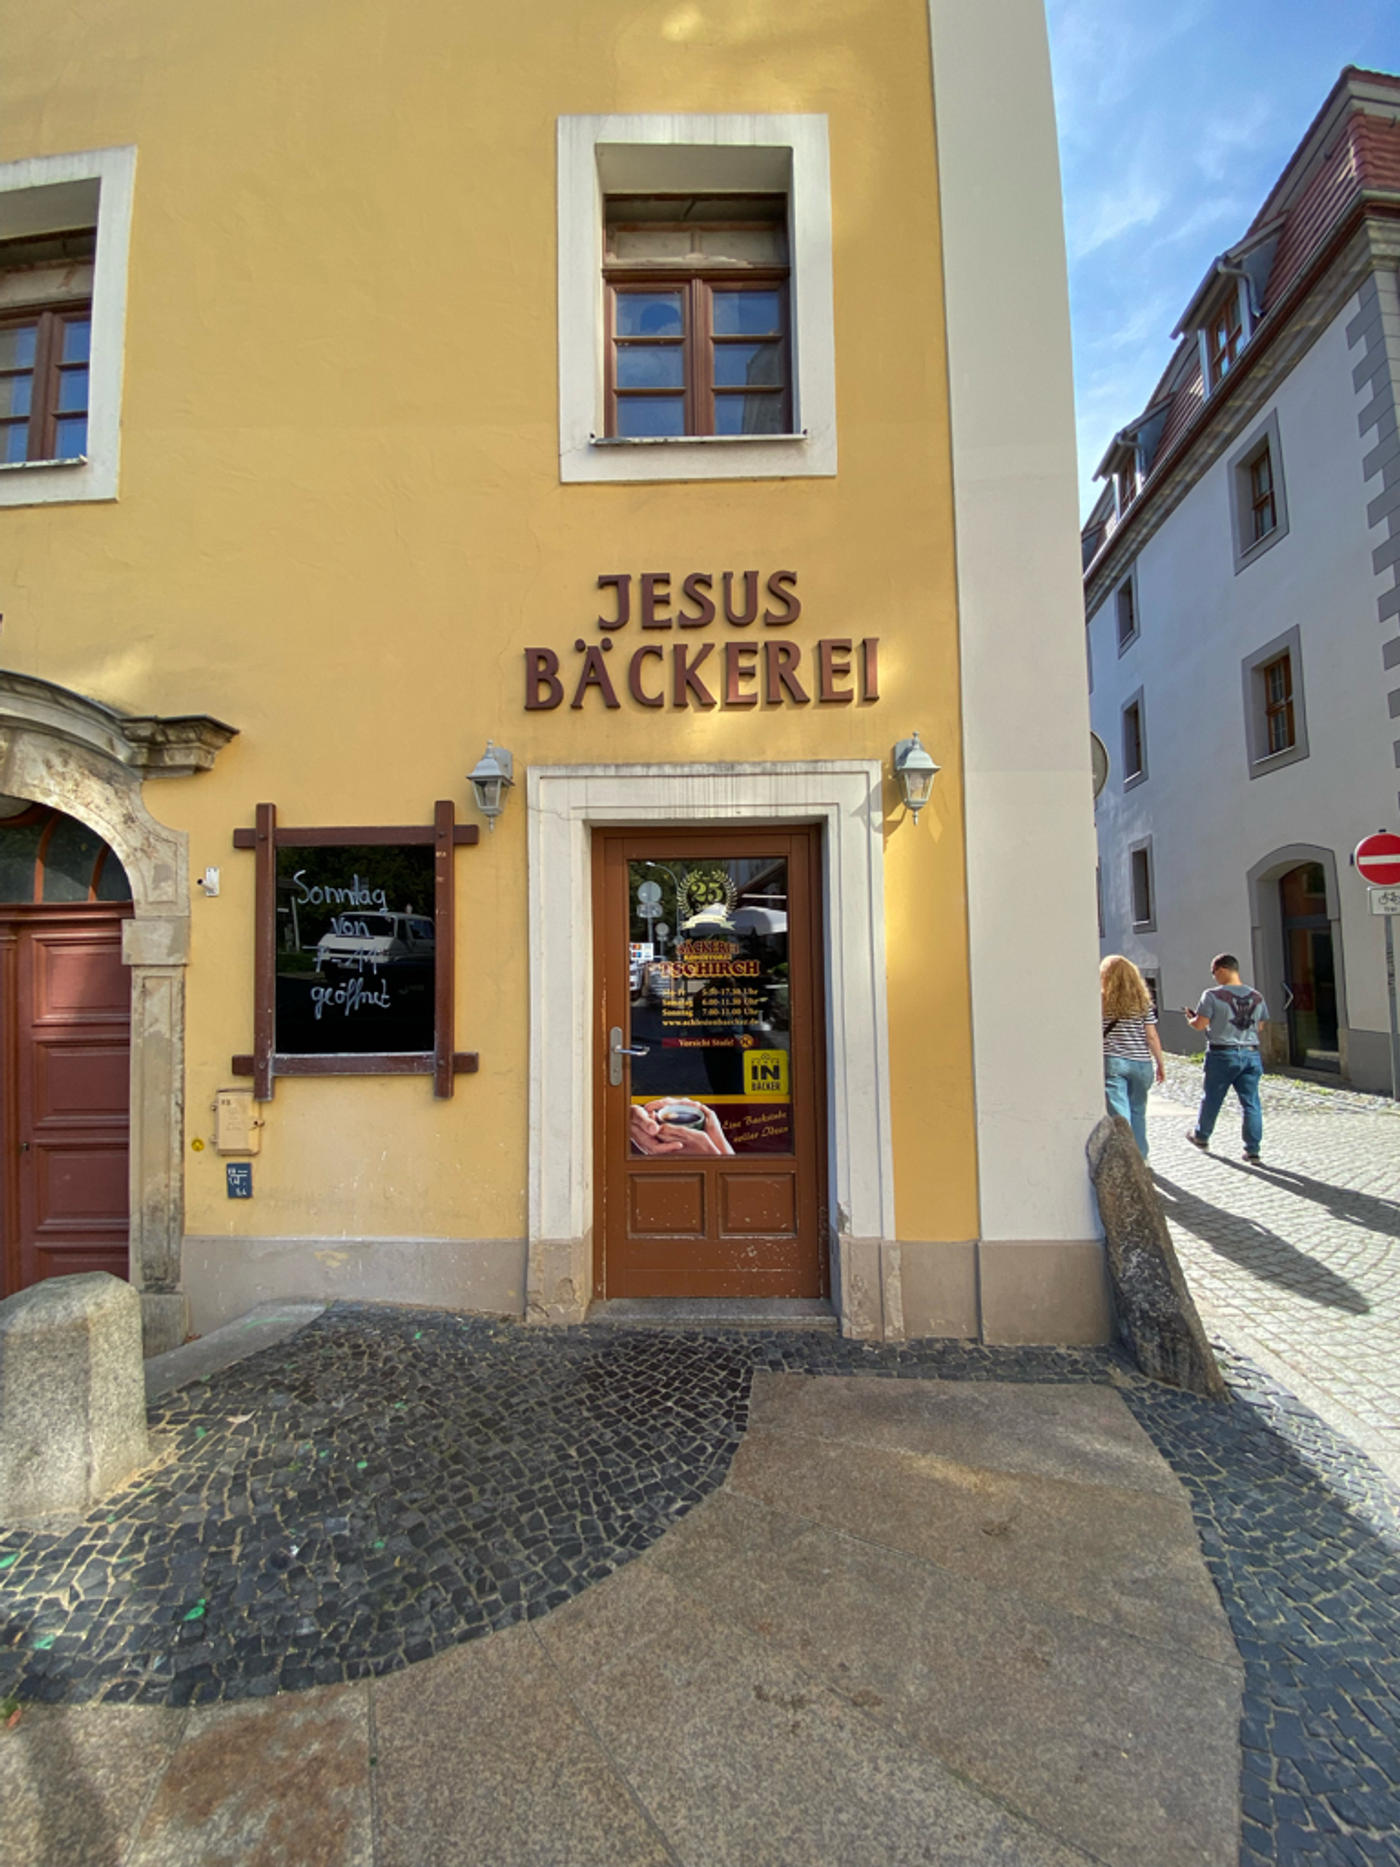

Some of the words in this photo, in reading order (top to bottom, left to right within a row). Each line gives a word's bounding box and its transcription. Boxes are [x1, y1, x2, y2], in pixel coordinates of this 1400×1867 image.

[597, 570, 801, 630] JESUS
[524, 637, 880, 711] BÄCKEREI
[293, 869, 389, 914] Sonntag
[691, 881, 723, 902] 25
[660, 960, 760, 978] TSCHIRCH
[310, 976, 391, 1020] geöffnet
[743, 987, 758, 996] Uhr
[662, 998, 693, 1008] Samstag
[744, 998, 759, 1007] Uhr
[662, 1008, 693, 1018] Sonntag
[744, 1008, 759, 1017] Uhr
[678, 1038, 711, 1047] Vorsicht
[752, 1065, 780, 1080] IN
[722, 1119, 742, 1130] Eine
[732, 1132, 759, 1143] voller
